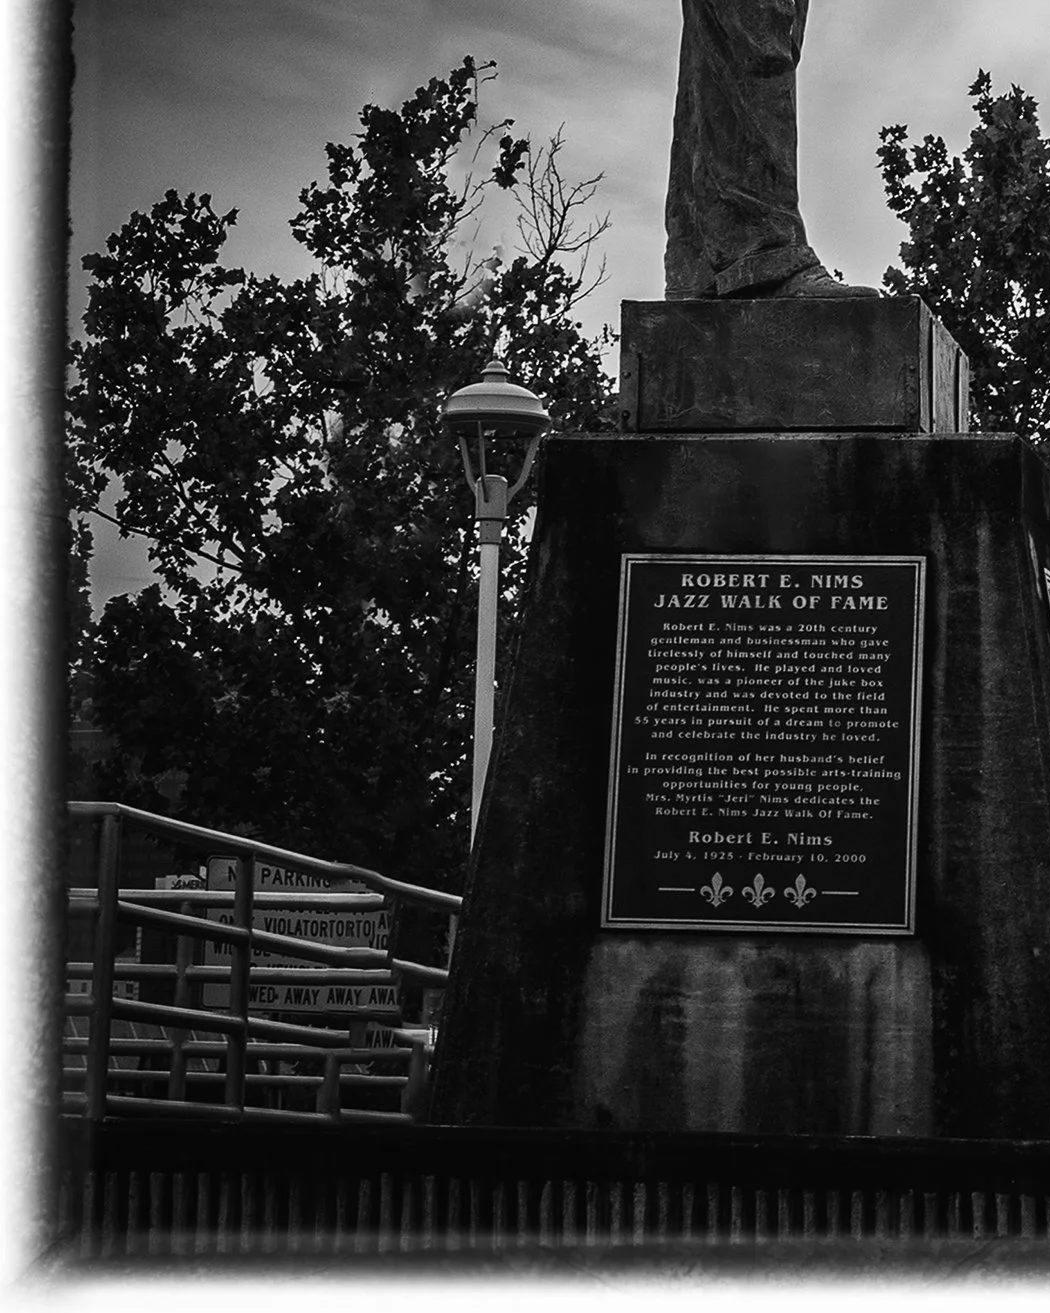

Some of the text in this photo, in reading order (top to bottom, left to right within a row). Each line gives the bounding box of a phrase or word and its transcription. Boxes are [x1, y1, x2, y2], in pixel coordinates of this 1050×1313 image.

[681, 573, 863, 588] ROBERT E. NIMS
[653, 594, 888, 610] JAZZ WALK OF FAME
[662, 622, 703, 631] Robert
[708, 622, 720, 631] E.
[724, 622, 754, 631] Nims
[798, 623, 826, 632] 20th
[830, 624, 878, 635] century
[650, 636, 889, 648] gentleman and businessman who gave
[648, 648, 891, 662] tirelessly of himself and touched many
[655, 662, 881, 674] people's lives. He played and loved
[736, 676, 783, 687] pioneer
[787, 676, 800, 686] of
[804, 677, 824, 686] the
[827, 677, 856, 688] juke
[860, 678, 883, 687] box
[649, 689, 701, 700] industry
[705, 690, 727, 698] and
[759, 690, 809, 699] devoted
[814, 691, 827, 699] to
[832, 691, 852, 700] the
[857, 691, 885, 700] field
[646, 702, 659, 711] of
[662, 702, 755, 712] entertainment.
[764, 704, 779, 712] He
[784, 704, 819, 715] spent
[859, 705, 887, 714] than
[634, 716, 649, 724] 55
[653, 718, 686, 727] years
[691, 716, 703, 725] in
[707, 716, 752, 727] pursuit
[756, 717, 770, 726] of
[785, 718, 823, 726] dream
[828, 719, 841, 727] to
[846, 719, 899, 730] promote
[650, 729, 880, 742] and celebrate the industry he loved.
[645, 751, 885, 764] In recognition of her husband's belief
[626, 765, 901, 780] in providing the best possible arts-training
[662, 779, 747, 790] opportunities
[752, 780, 770, 789] for
[774, 782, 812, 792] young
[645, 793, 671, 801] Mrs.
[675, 792, 713, 804] Myrtis
[759, 794, 789, 803] Nims
[793, 795, 855, 804] dedicates
[859, 796, 880, 805] the
[655, 806, 873, 819] Robert E. Nims Jazz Walk Of Fame.
[688, 831, 832, 845] Robert E. Nims
[653, 850, 680, 861] July
[703, 851, 734, 860] 1925
[747, 852, 804, 863] February
[834, 853, 866, 863] 2000
[284, 987, 320, 1005] AWAY
[326, 987, 362, 1005] AWAY
[368, 987, 397, 1006] AWA
